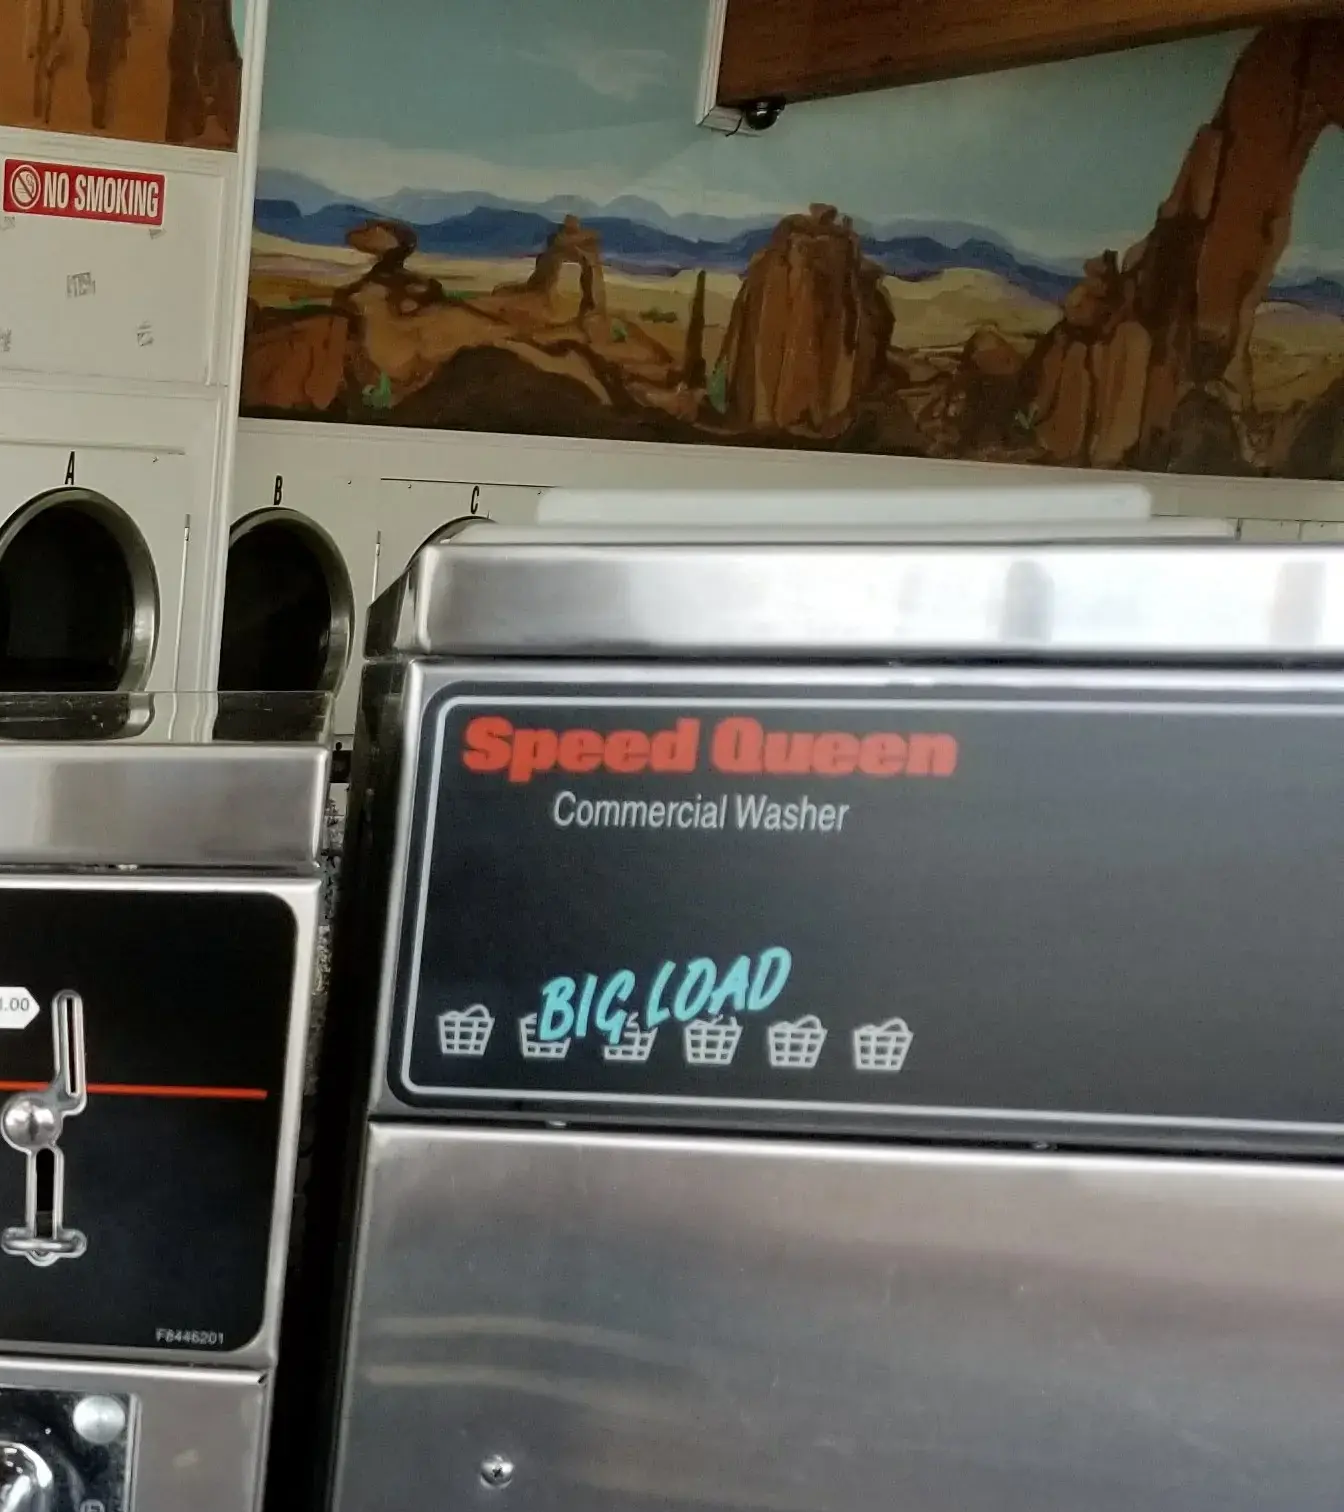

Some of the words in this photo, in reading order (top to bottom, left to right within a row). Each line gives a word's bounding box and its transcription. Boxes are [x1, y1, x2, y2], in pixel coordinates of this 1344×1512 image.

[43, 171, 70, 208] NO
[74, 175, 160, 218] SMOKING
[65, 451, 76, 486] A
[273, 475, 283, 506] B
[470, 485, 480, 515] C
[462, 715, 700, 783] Speed
[712, 717, 959, 778] Queen
[552, 790, 726, 829] Commercial
[735, 797, 850, 832] Washer
[539, 969, 636, 1045] BIG
[646, 946, 792, 1029] LOAD
